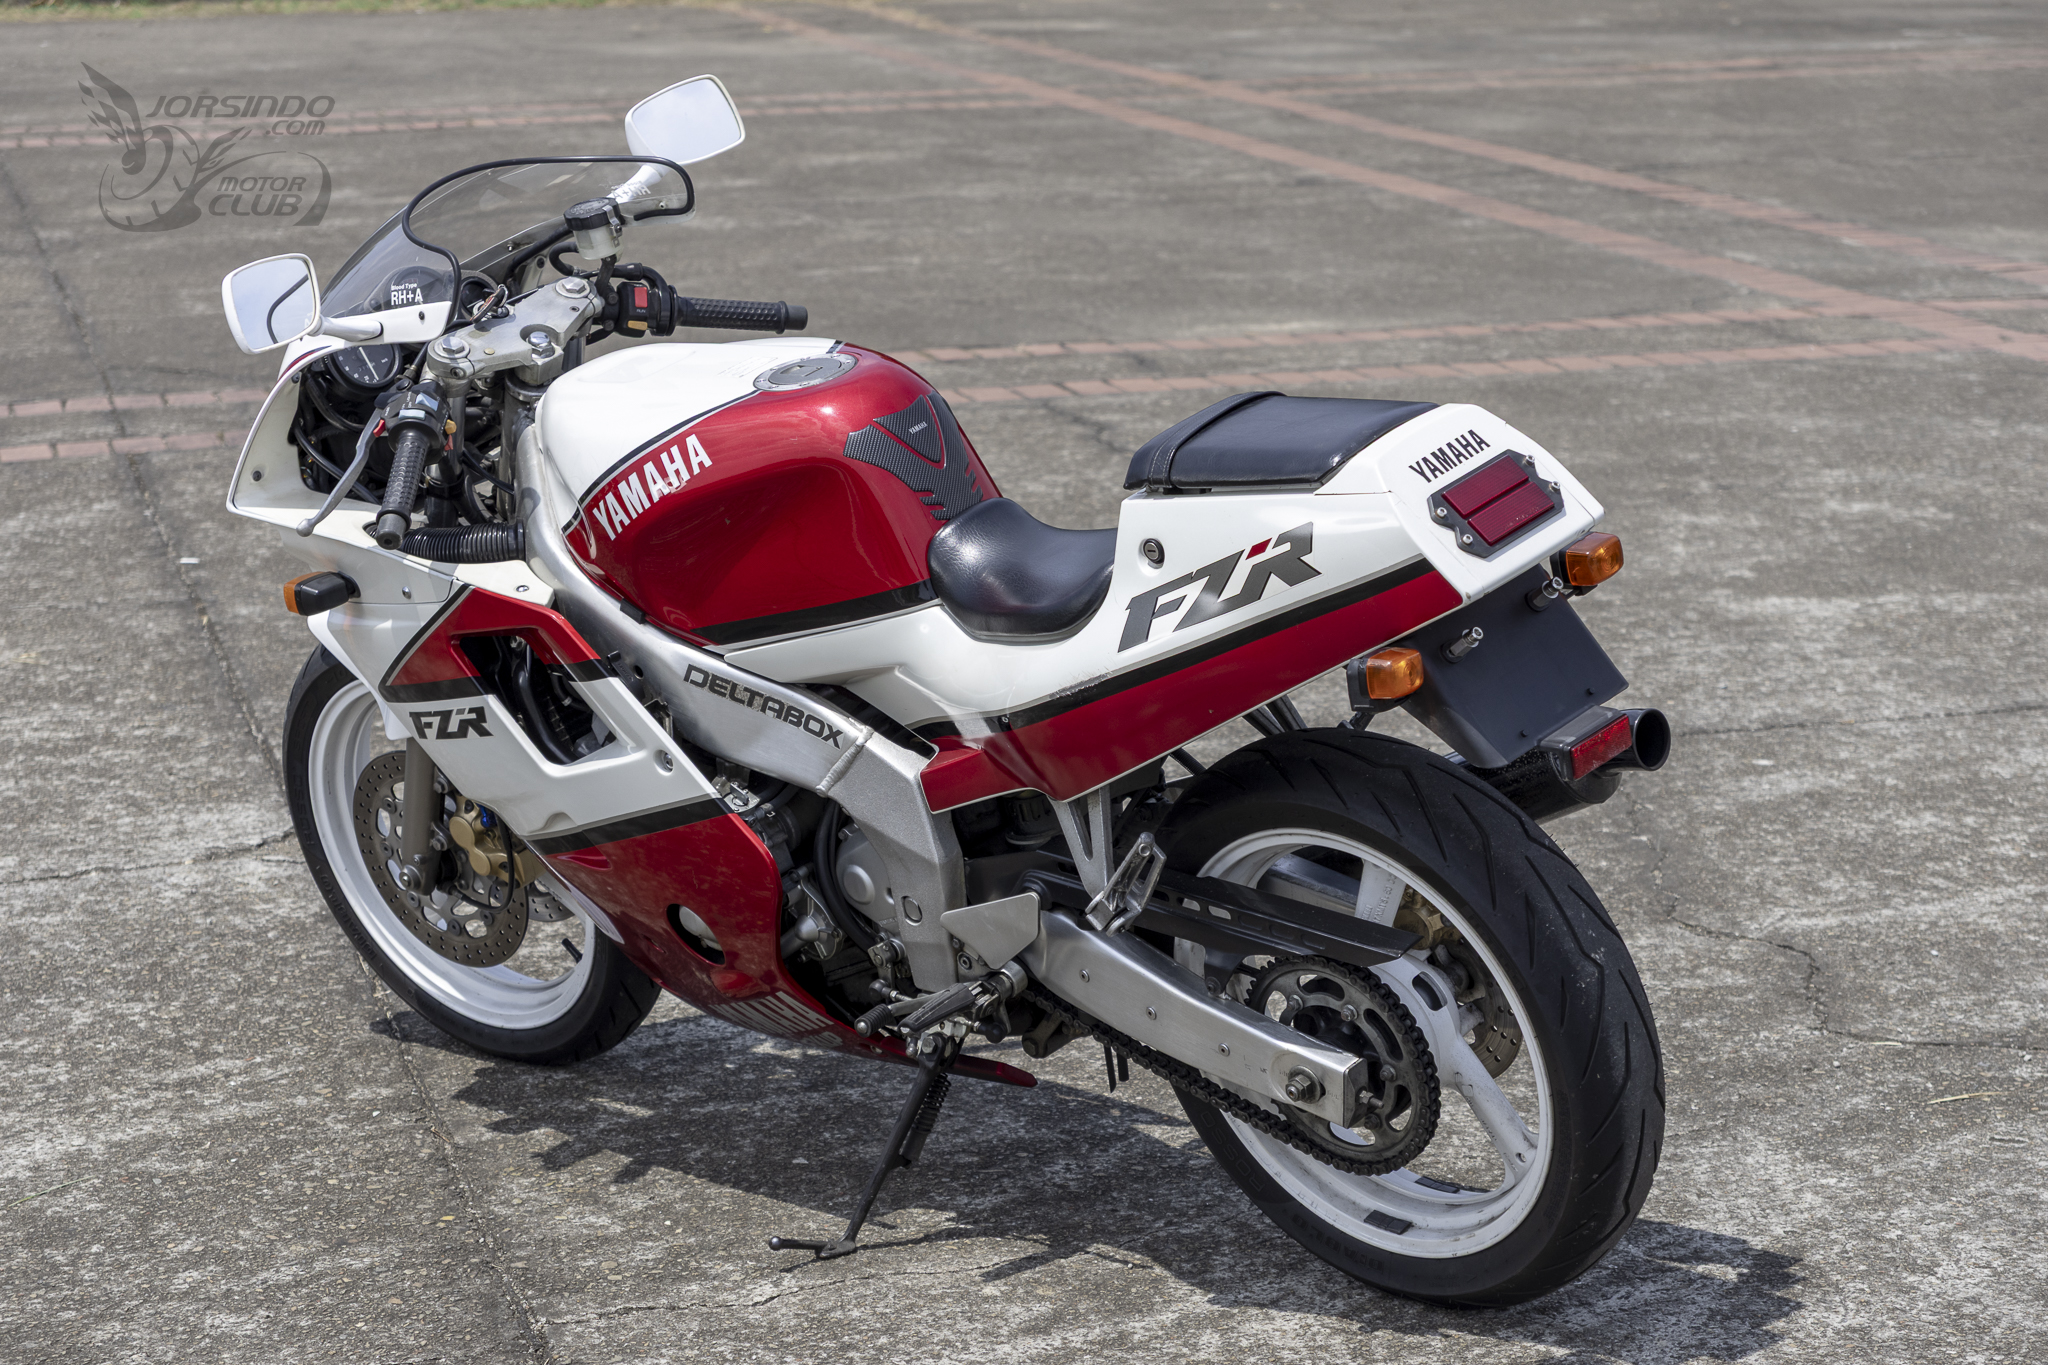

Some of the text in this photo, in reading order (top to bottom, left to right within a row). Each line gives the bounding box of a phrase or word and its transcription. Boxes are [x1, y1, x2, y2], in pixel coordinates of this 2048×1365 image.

[391, 288, 423, 305] RH+A
[908, 421, 928, 435] YAMAHA
[1408, 429, 1491, 483] YAMAHA
[592, 433, 713, 541] YAMAHA
[1117, 521, 1323, 653] FZR
[408, 706, 495, 740] FZR
[683, 663, 844, 750] DELTABOX
[707, 990, 835, 1036] YAMAHA
